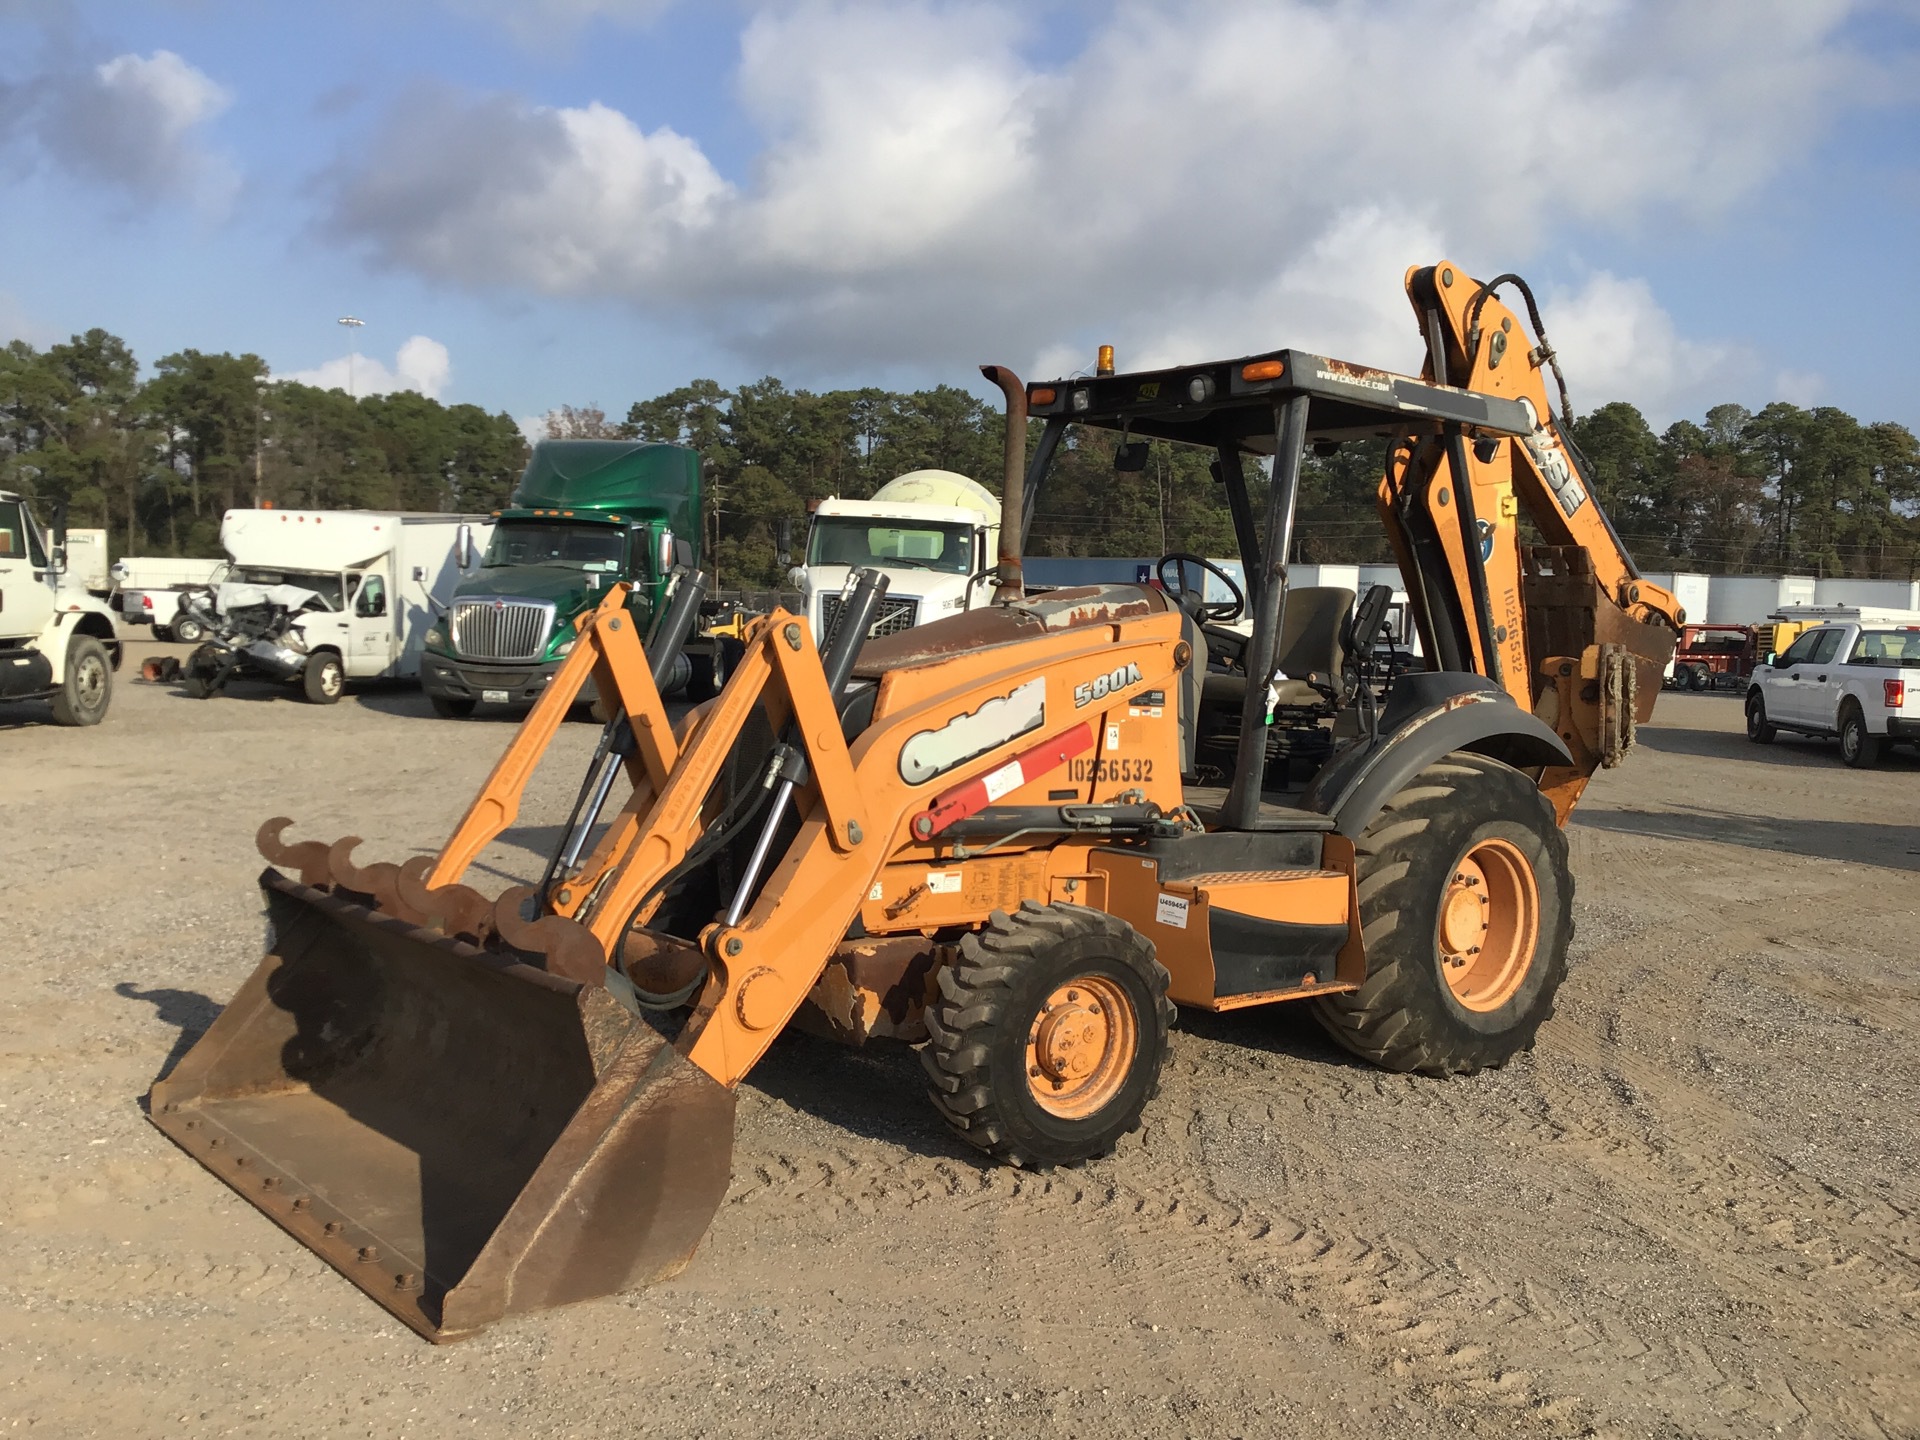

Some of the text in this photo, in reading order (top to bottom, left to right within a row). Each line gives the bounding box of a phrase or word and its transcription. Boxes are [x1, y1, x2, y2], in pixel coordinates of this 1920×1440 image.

[1316, 369, 1390, 392] WWW.CASECE.COM
[1503, 588, 1523, 674] 10256532
[1067, 758, 1154, 783] 10256532
